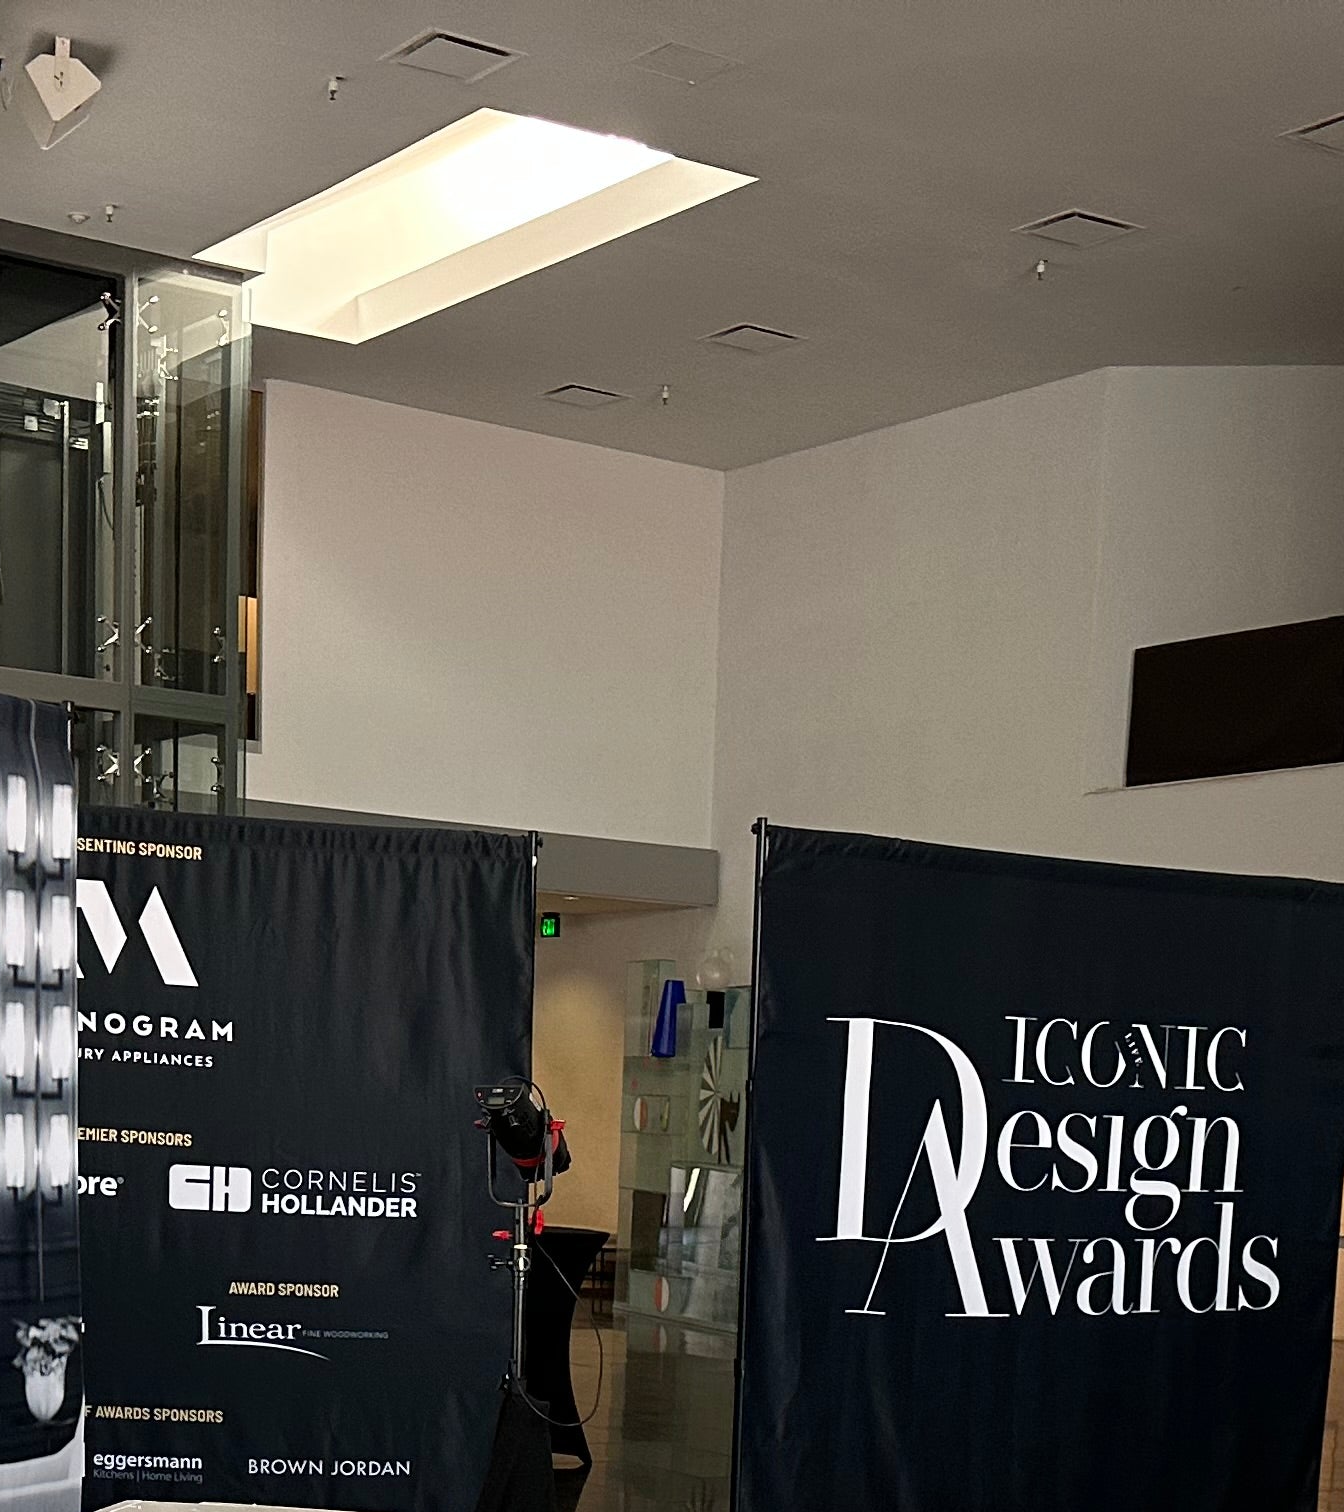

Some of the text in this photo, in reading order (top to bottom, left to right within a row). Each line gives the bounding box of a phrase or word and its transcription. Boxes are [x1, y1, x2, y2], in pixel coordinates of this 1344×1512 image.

[138, 842, 202, 860] SPONSOR
[111, 1050, 214, 1068] APPLIANCES
[1002, 1016, 1247, 1091] ICONIC
[120, 1130, 193, 1147] SPONSORS
[261, 1193, 418, 1218] HOLLANDER
[228, 1282, 339, 1298] AWARD SPONSOR
[196, 1305, 302, 1346] Linear
[95, 1406, 150, 1420] AWARDS
[153, 1408, 224, 1423] SPONSORS
[93, 1453, 203, 1470] eggersmann
[248, 1458, 411, 1476] BROWN JORDAN
[93, 1468, 204, 1485] Kitchens Home Living
